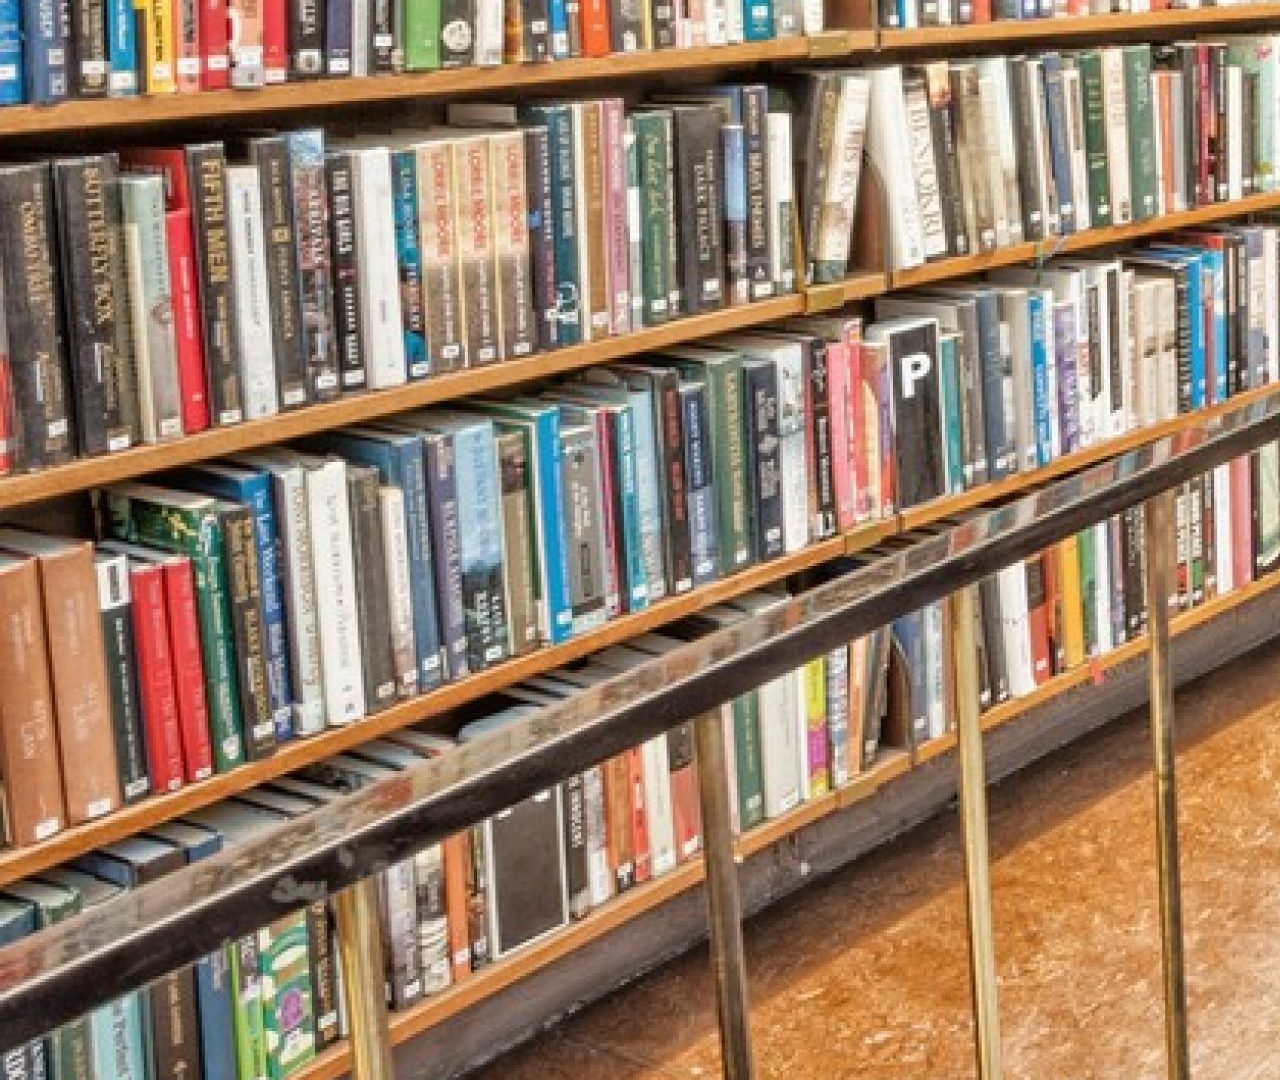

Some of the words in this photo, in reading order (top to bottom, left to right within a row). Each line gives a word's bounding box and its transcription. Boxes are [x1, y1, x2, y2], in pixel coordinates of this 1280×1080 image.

[201, 159, 224, 222] FIFTH
[207, 228, 228, 284] MEN
[94, 283, 113, 325] BOX
[900, 353, 931, 398] P
